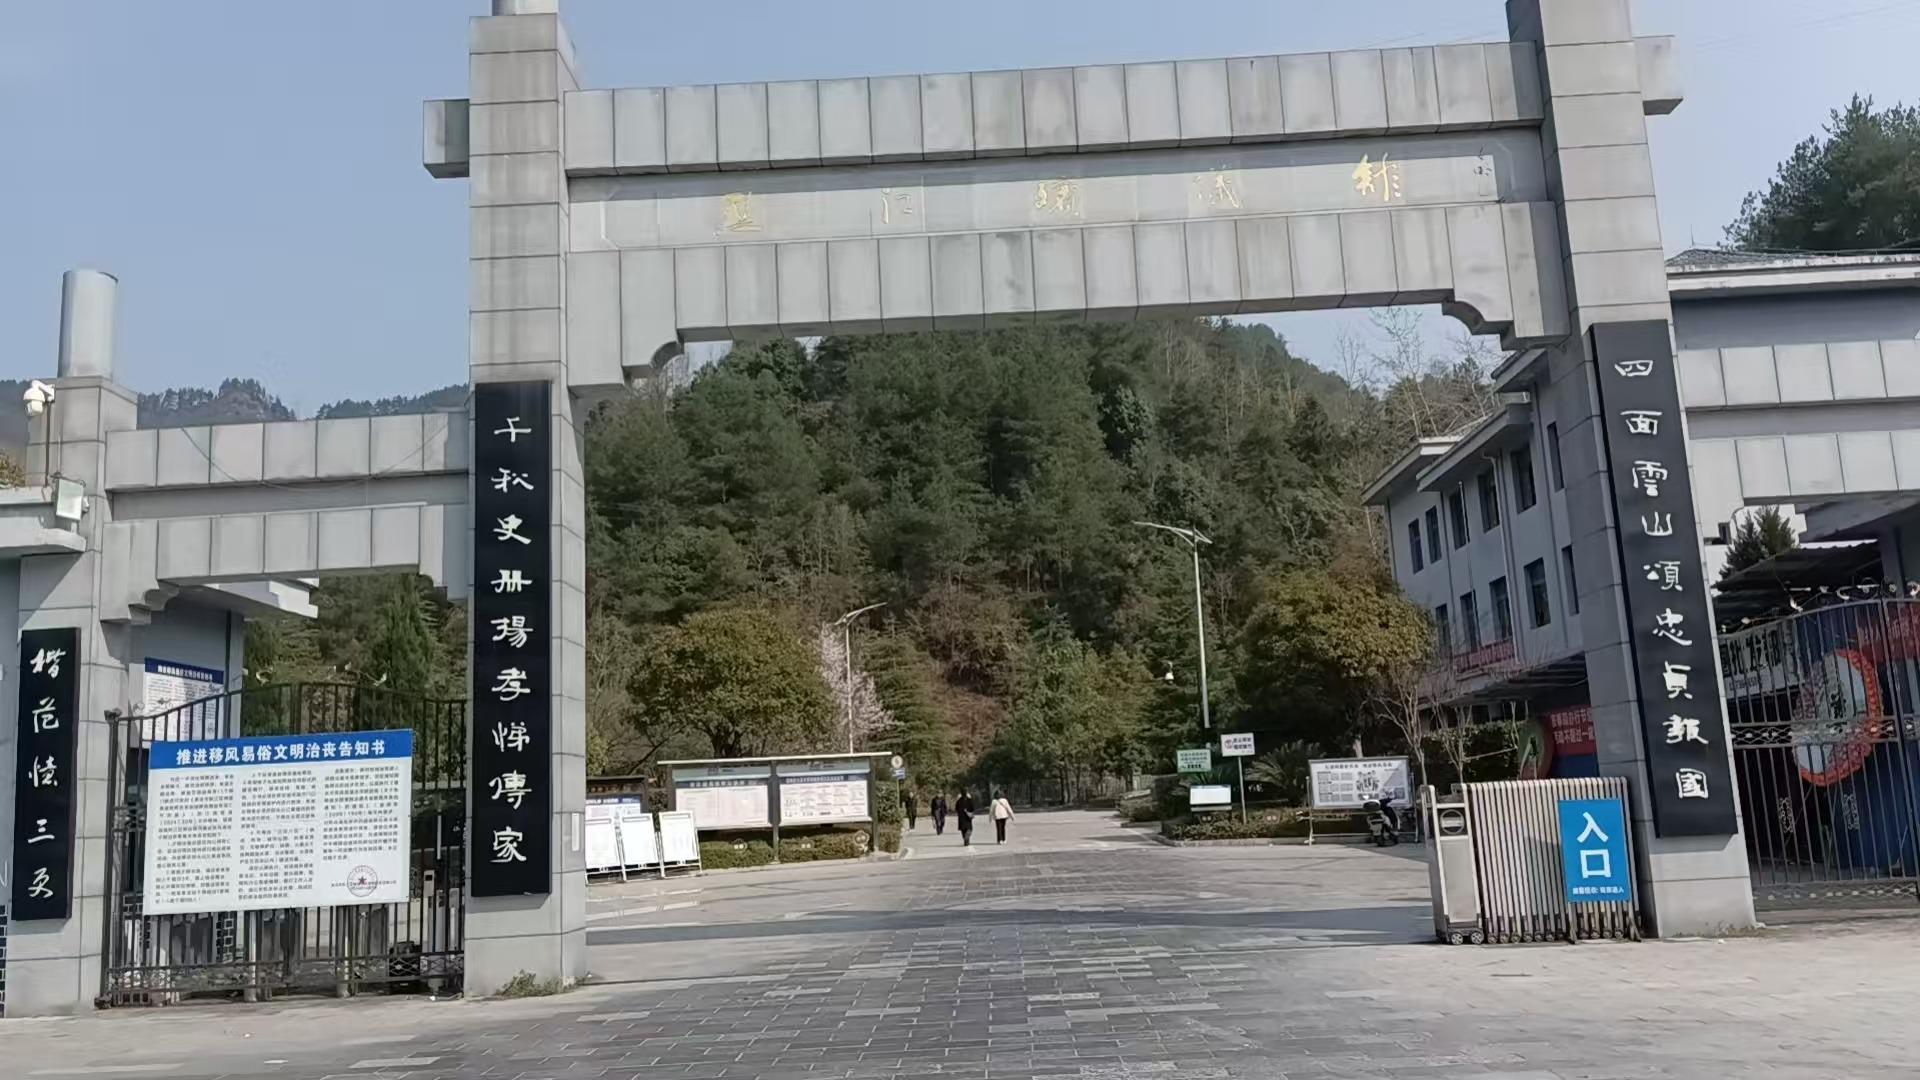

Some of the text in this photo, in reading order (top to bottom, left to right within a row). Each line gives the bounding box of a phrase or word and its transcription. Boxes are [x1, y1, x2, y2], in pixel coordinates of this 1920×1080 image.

[176, 739, 386, 766] 推进移风易俗文明治丧告知书
[1576, 811, 1612, 879] 入口
